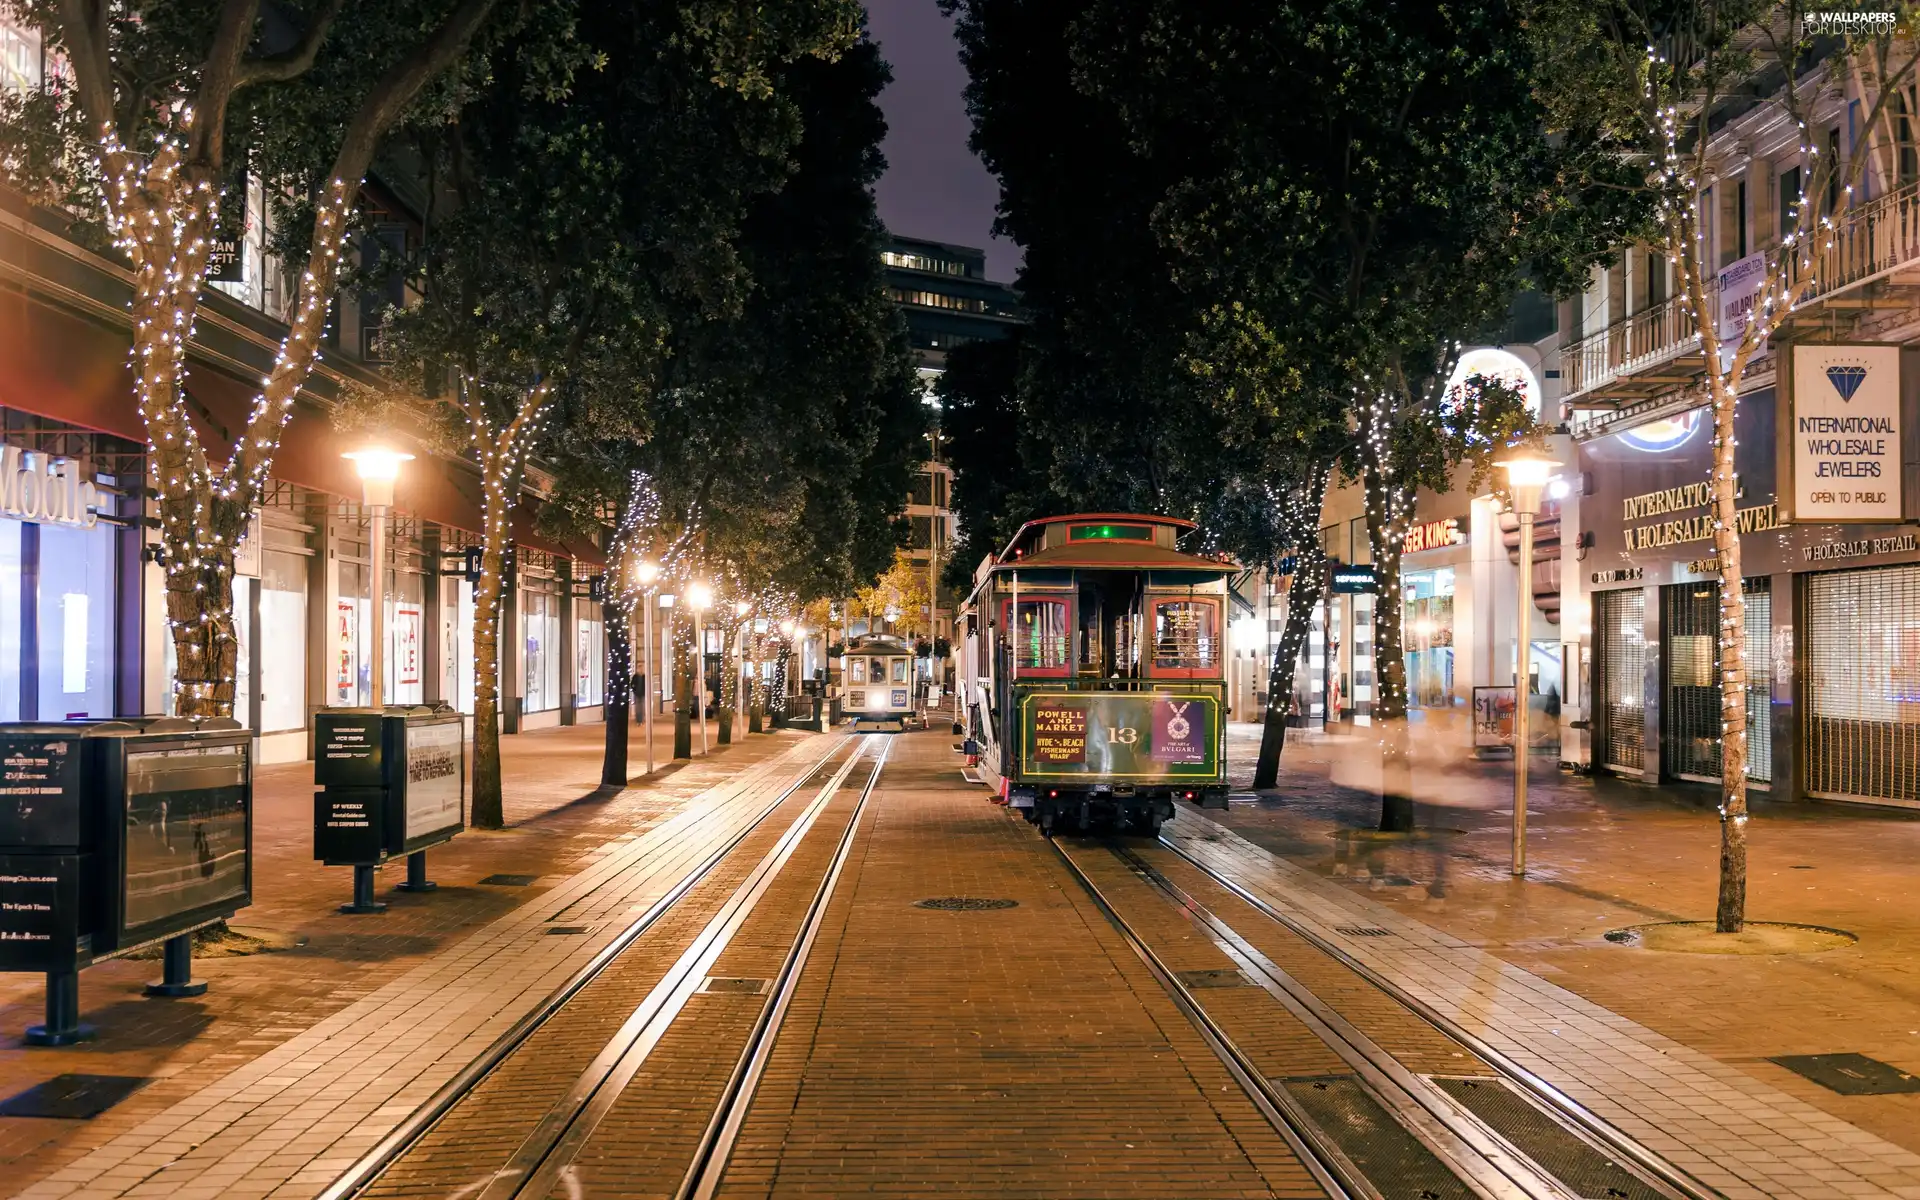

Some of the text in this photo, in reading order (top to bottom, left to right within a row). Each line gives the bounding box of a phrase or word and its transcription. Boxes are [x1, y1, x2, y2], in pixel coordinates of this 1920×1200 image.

[1799, 417, 1895, 433] INTERNATIONAL
[1808, 439, 1885, 455] WHOLESALE
[1815, 462, 1881, 477] JEWELERS
[1624, 477, 1743, 521] INTERNATIOL
[1811, 492, 1886, 503] OPEN TO PUBLIC
[1426, 520, 1451, 549] KING
[1624, 516, 1715, 551] WHOLESALE
[1802, 535, 1916, 561] WHOLESALE RETAIL
[1037, 711, 1084, 719] POWELL
[1036, 723, 1084, 731] MARKET
[1037, 738, 1053, 747] HYDE
[1063, 738, 1084, 747] BEACH
[1108, 727, 1137, 744] 13
[14, 903, 33, 911] Epoch
